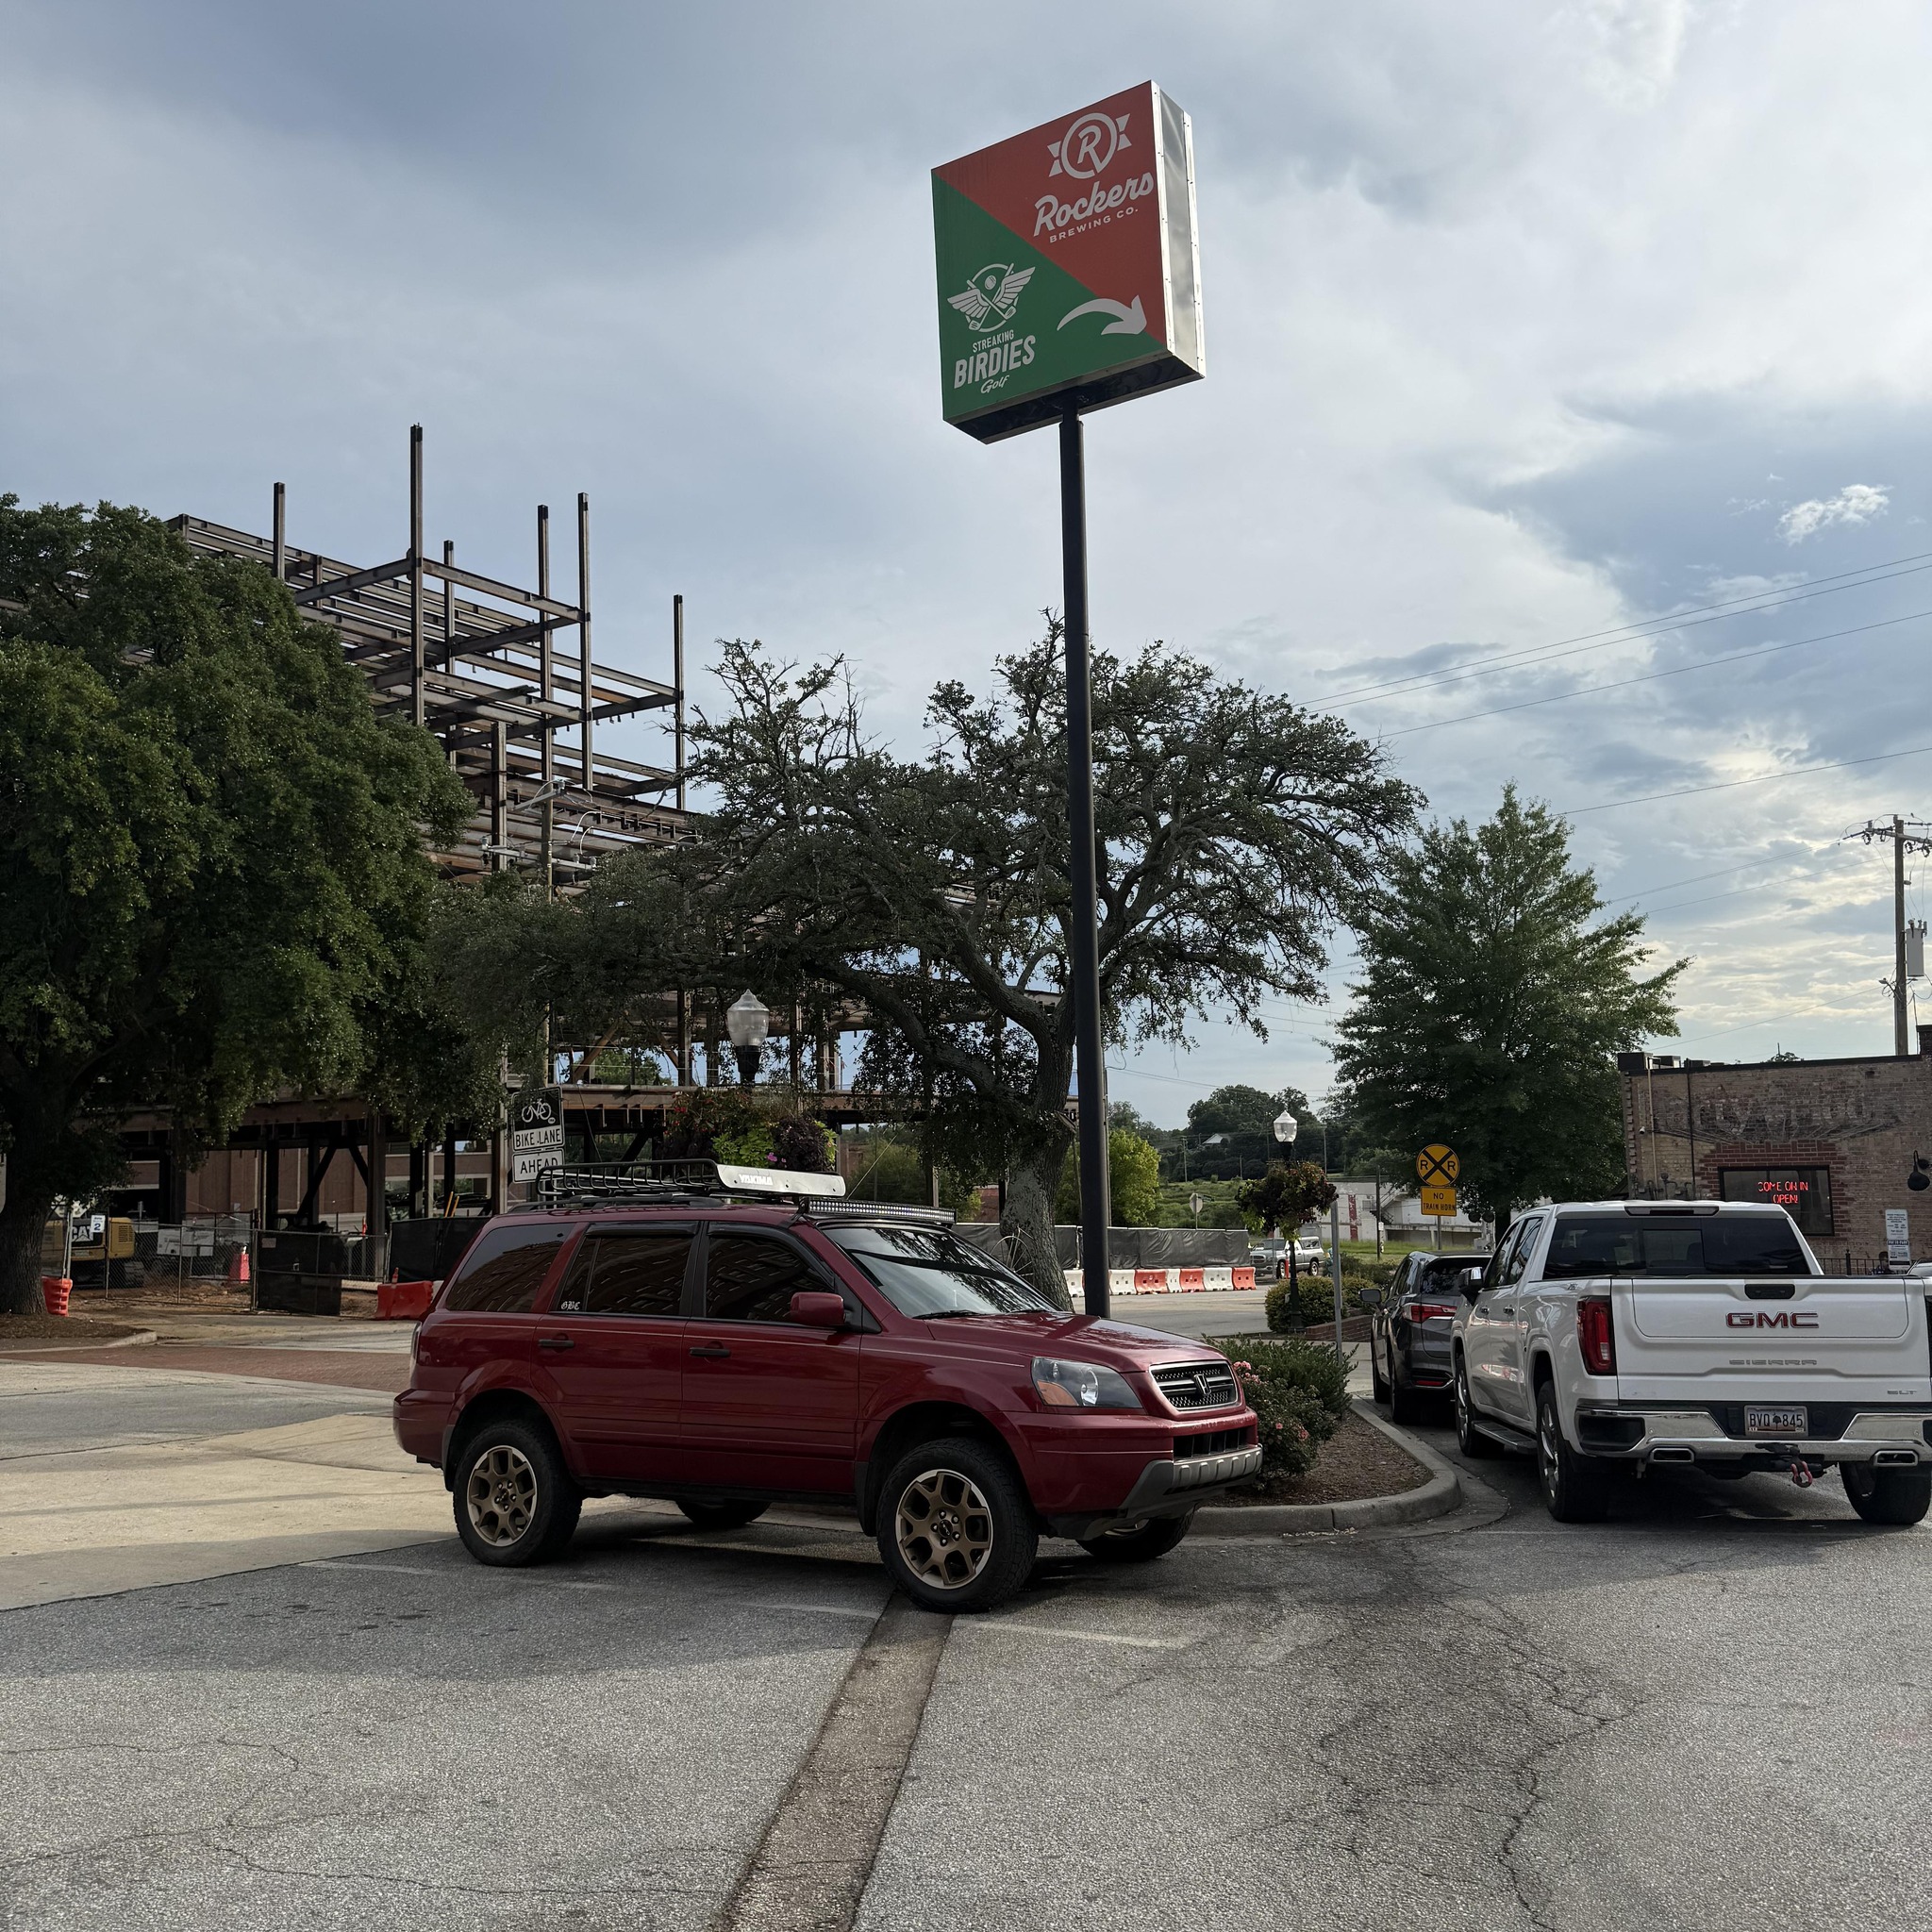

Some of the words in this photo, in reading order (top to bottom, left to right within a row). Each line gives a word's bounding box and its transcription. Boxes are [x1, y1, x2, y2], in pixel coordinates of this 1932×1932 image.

[1033, 172, 1155, 237] Rockers
[1049, 215, 1111, 243] BREWING
[1116, 207, 1139, 219] CO.
[973, 329, 1015, 353] STREAKING
[954, 335, 1037, 390] BIRDIES
[980, 375, 1010, 394] Golf
[515, 1132, 535, 1148] BIKE
[539, 1128, 561, 1145] LANE
[1420, 1160, 1428, 1171] R
[1447, 1161, 1456, 1172] R
[739, 1174, 774, 1186] YAKIMA
[1757, 1181, 1782, 1192] COME
[1784, 1181, 1798, 1191] ON
[1799, 1181, 1808, 1191] IN
[1773, 1193, 1798, 1204] OPEN!
[93, 1223, 101, 1231] 2
[1725, 1311, 1820, 1328] GMC
[1749, 1413, 1771, 1427] BVQ
[1782, 1413, 1804, 1427] 845
